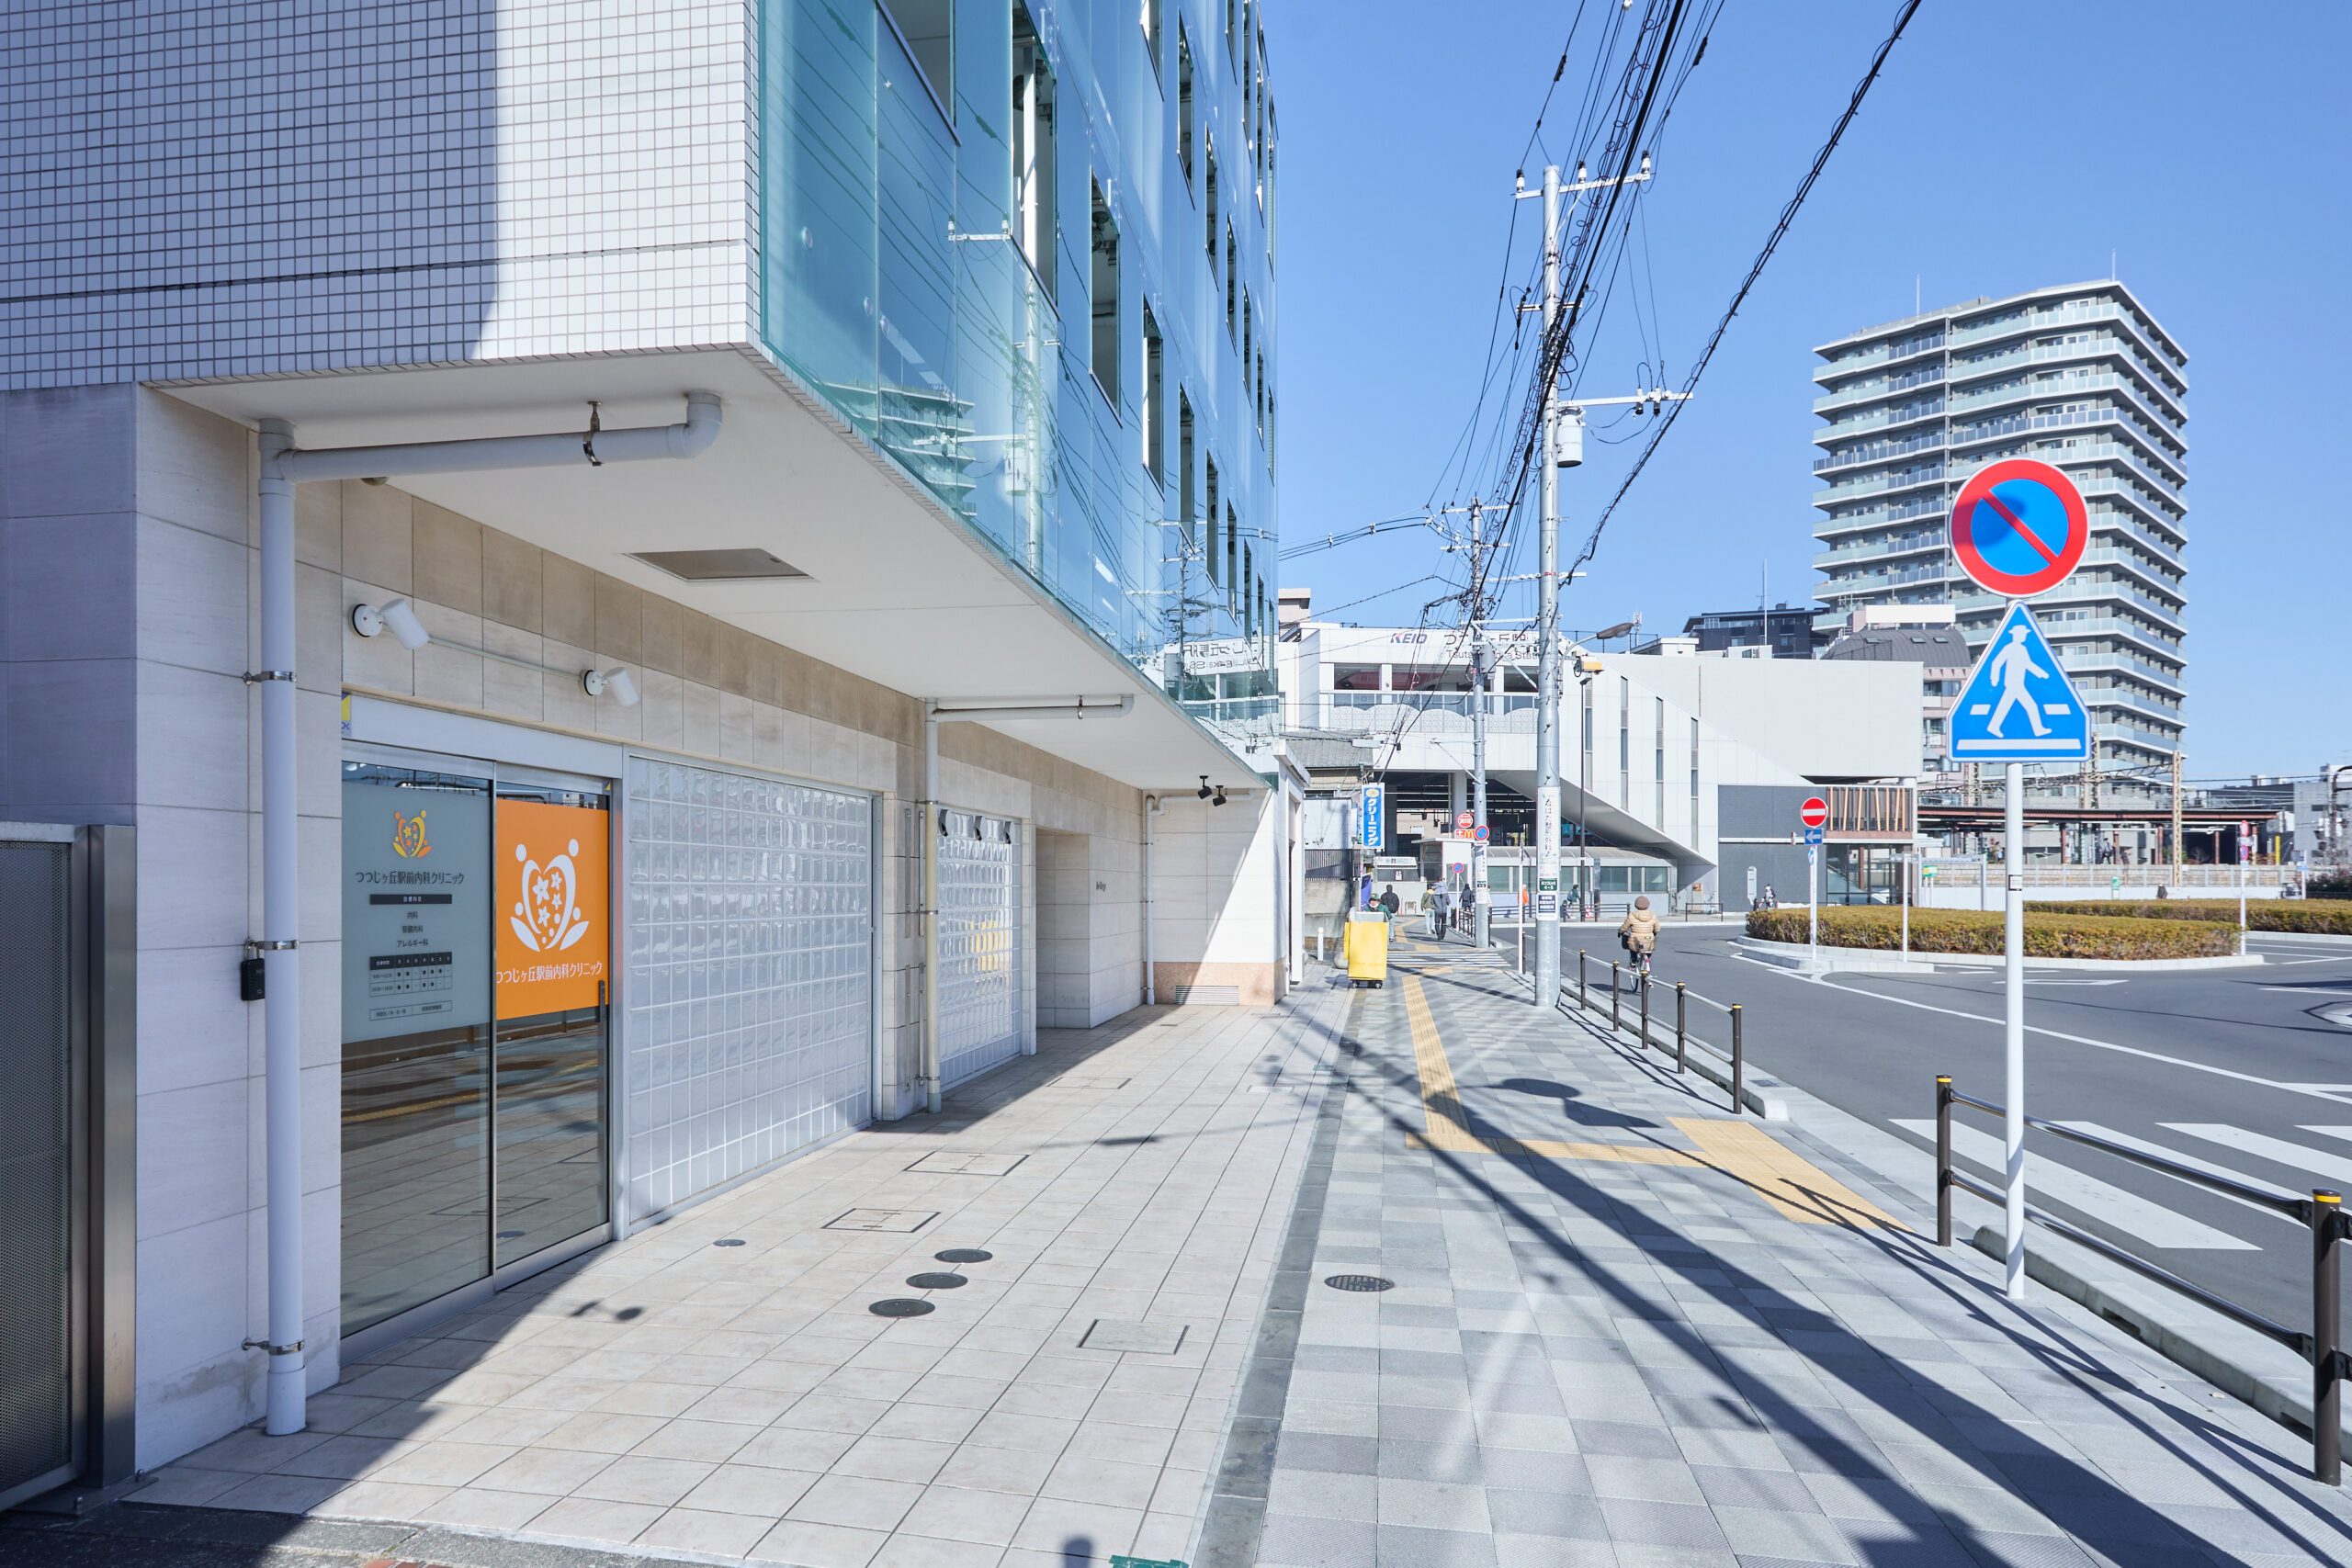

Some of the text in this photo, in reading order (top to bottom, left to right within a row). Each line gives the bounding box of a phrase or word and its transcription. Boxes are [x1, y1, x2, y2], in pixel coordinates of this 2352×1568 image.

[1390, 632, 1428, 644] KEIO
[1367, 797, 1379, 846] クリーニング
[407, 910, 419, 919] 内科
